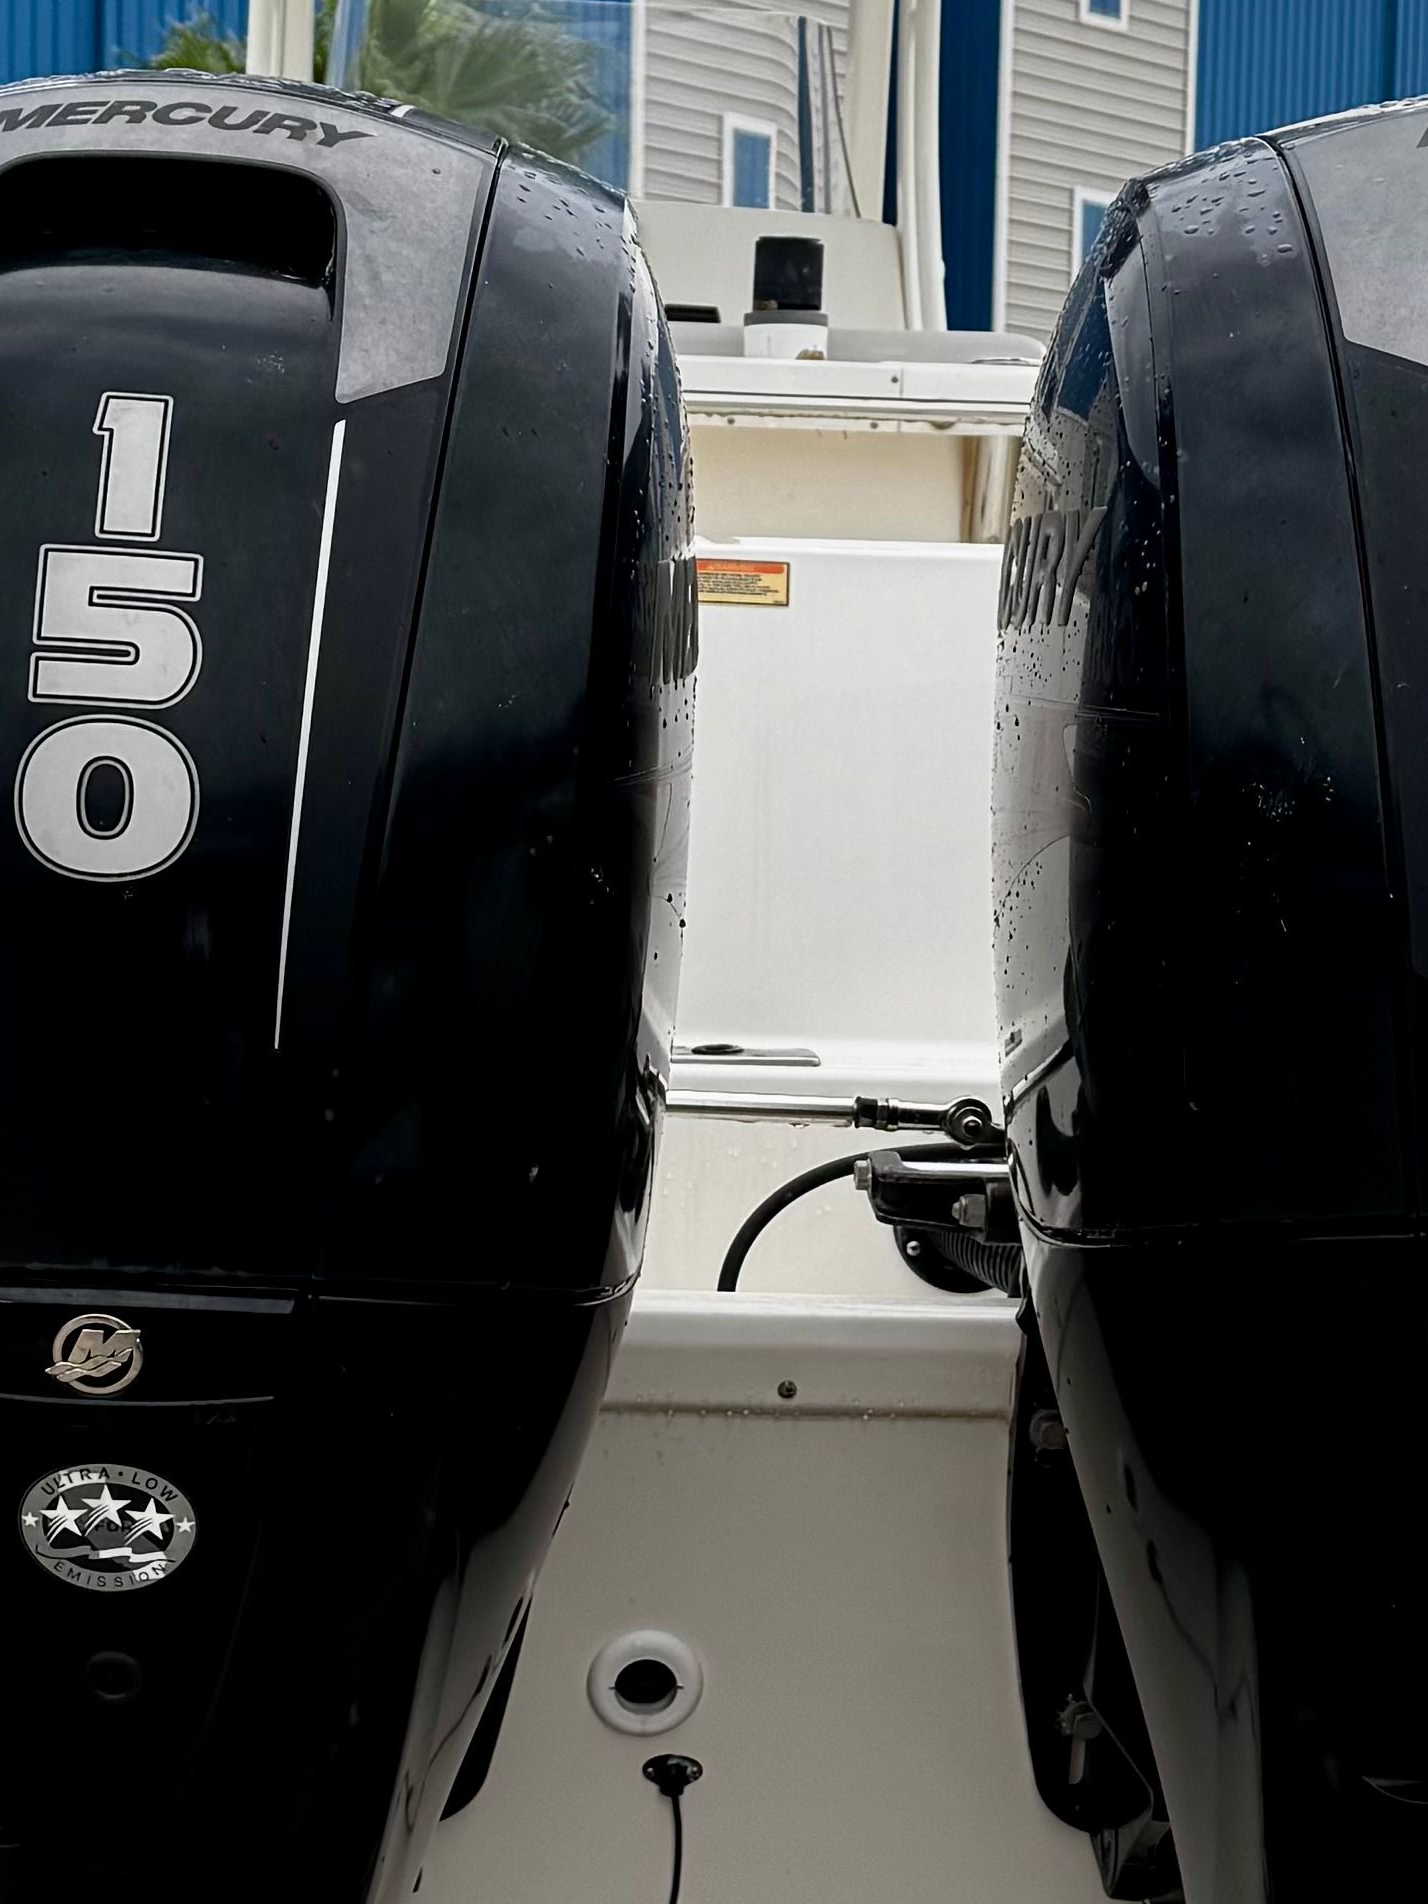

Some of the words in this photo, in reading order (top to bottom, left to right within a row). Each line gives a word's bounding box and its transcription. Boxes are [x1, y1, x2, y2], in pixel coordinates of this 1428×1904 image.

[14, 391, 205, 883] 150
[40, 1466, 111, 1496] ULTRA
[131, 1471, 179, 1503] LOW
[53, 1560, 167, 1588] EMISSION
